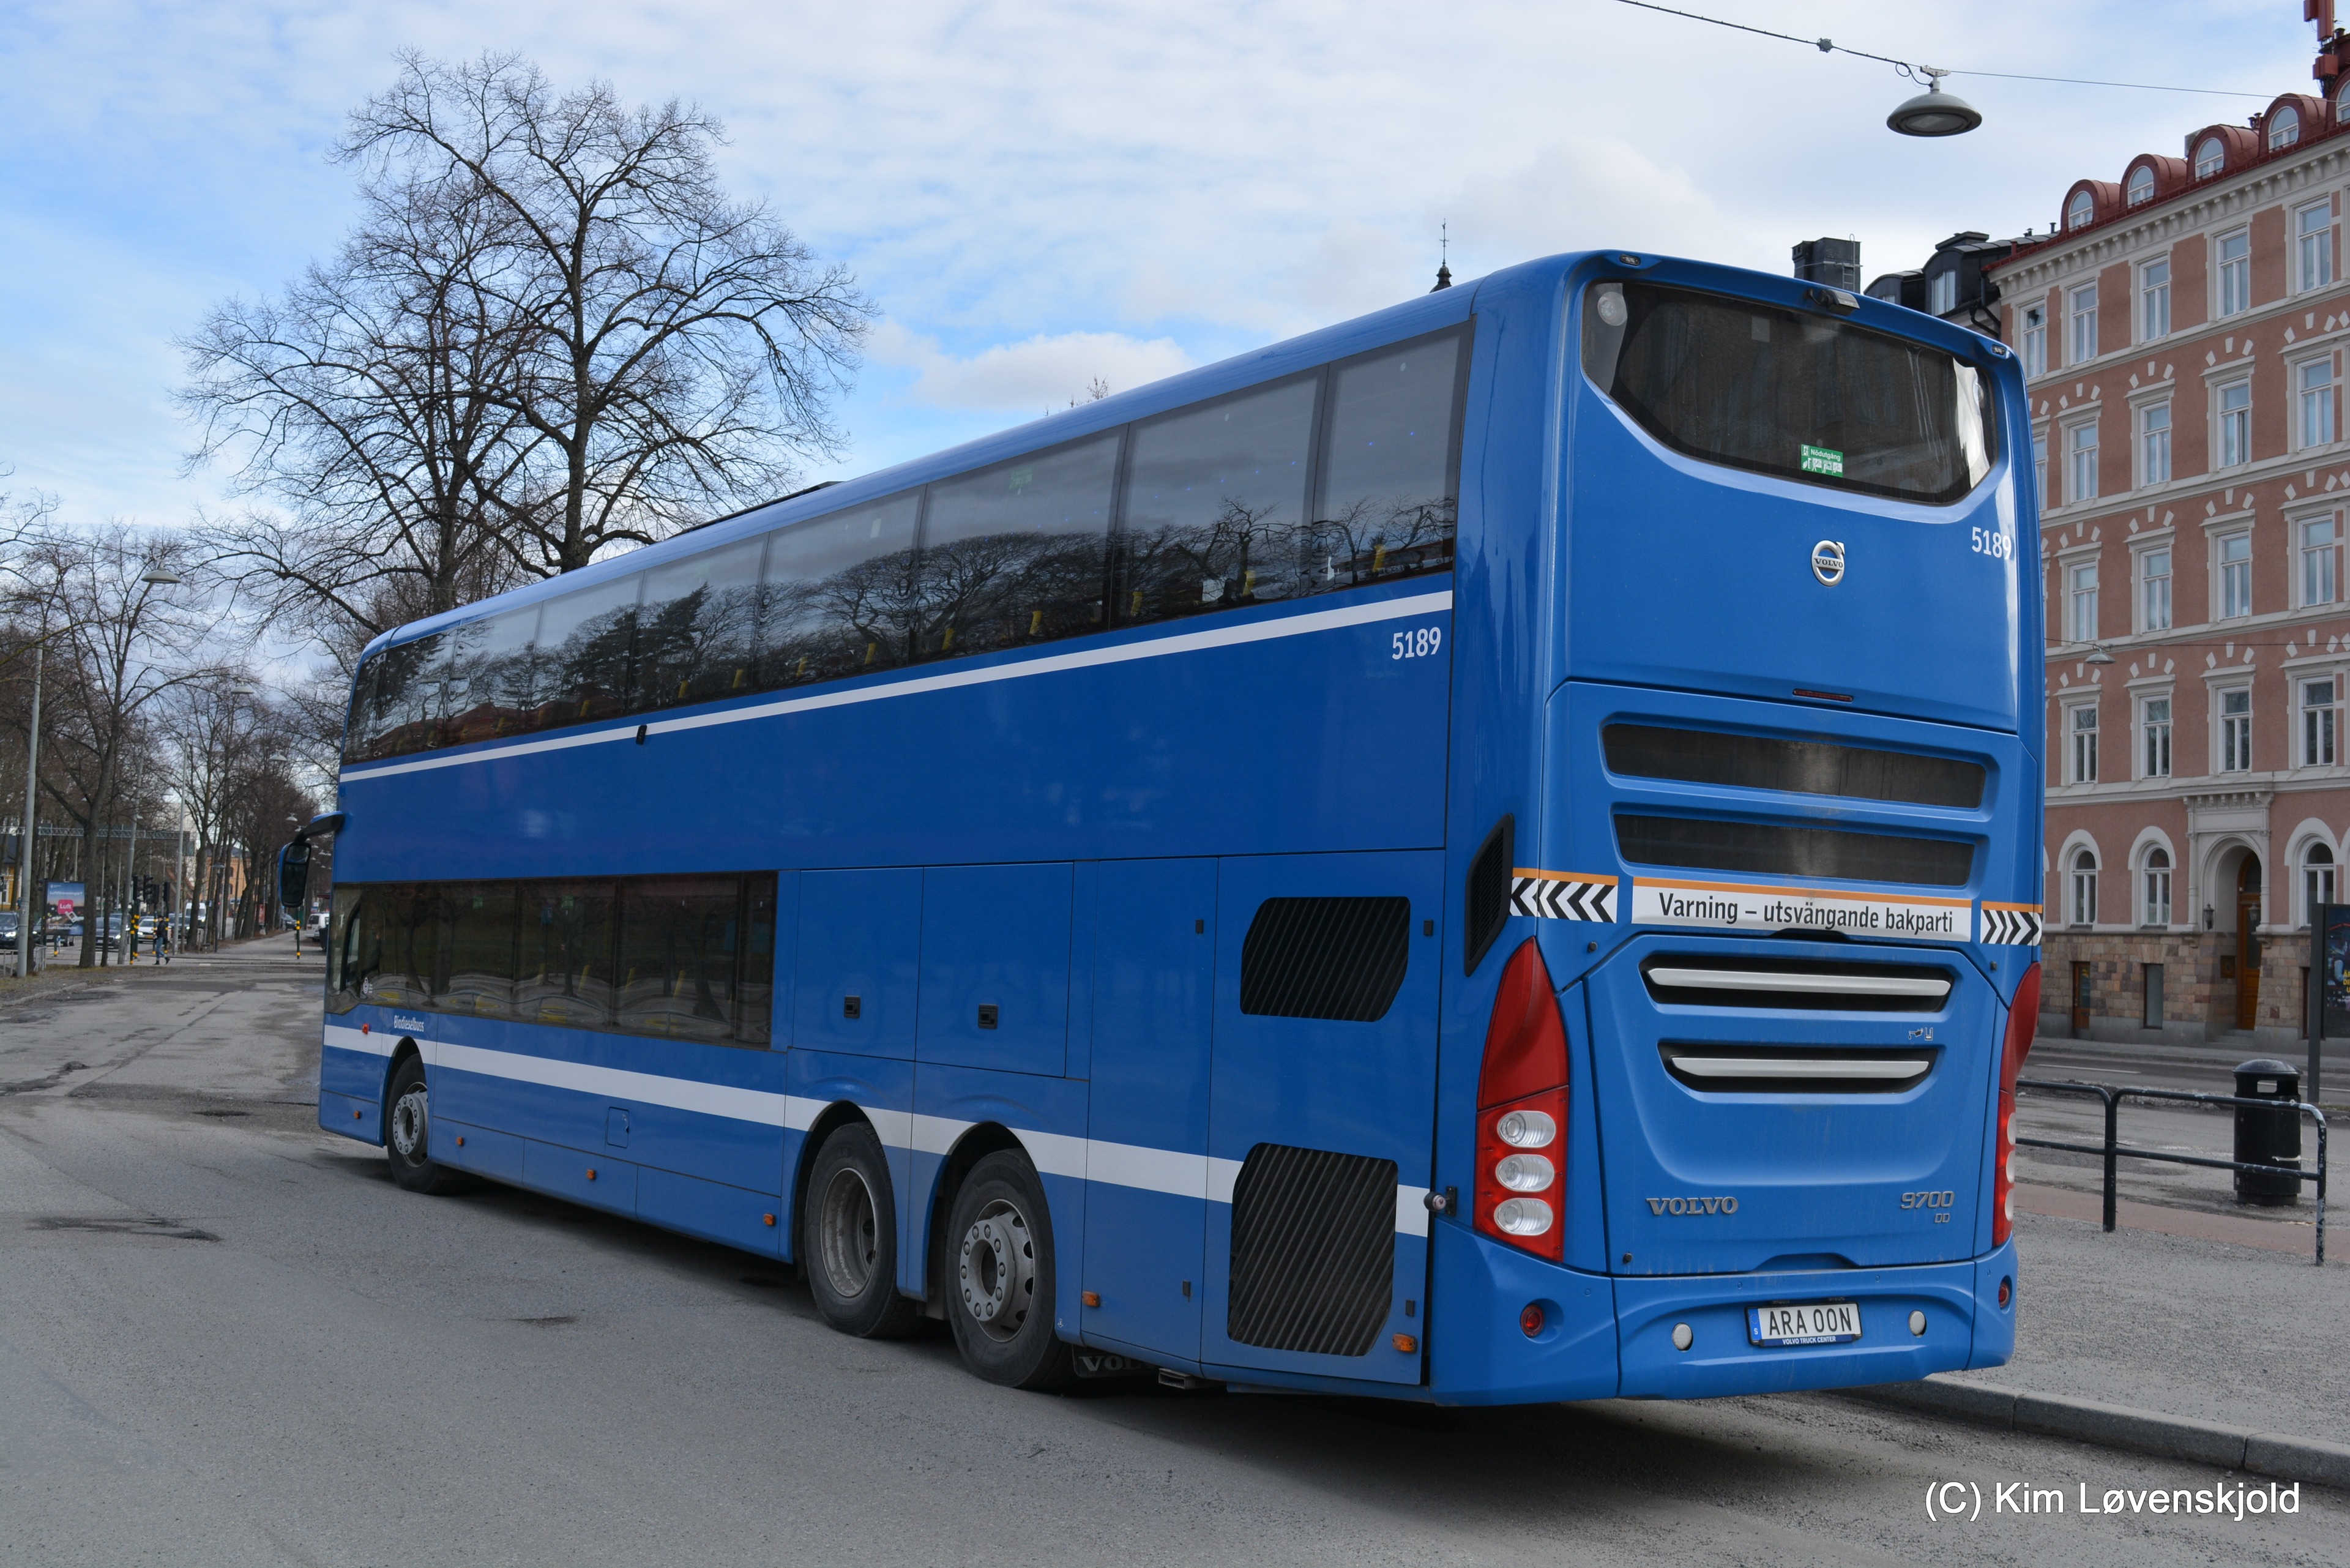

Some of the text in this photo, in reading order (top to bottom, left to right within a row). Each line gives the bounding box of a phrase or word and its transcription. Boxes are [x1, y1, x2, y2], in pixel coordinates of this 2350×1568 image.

[1810, 449, 1841, 462] Nödutgång
[1972, 526, 2012, 558] 5189
[1814, 558, 1843, 568] VOLVO
[1392, 627, 1441, 660] 5189
[1659, 892, 1738, 924] Varning
[1764, 901, 1879, 930] utsvängande
[1886, 908, 1952, 935] bakparti
[394, 1015, 424, 1032] Biodieselbuss
[1646, 1191, 1955, 1215] VOLVO 9700
[1934, 1213, 1950, 1223] DD
[1769, 1310, 1808, 1336] ARA
